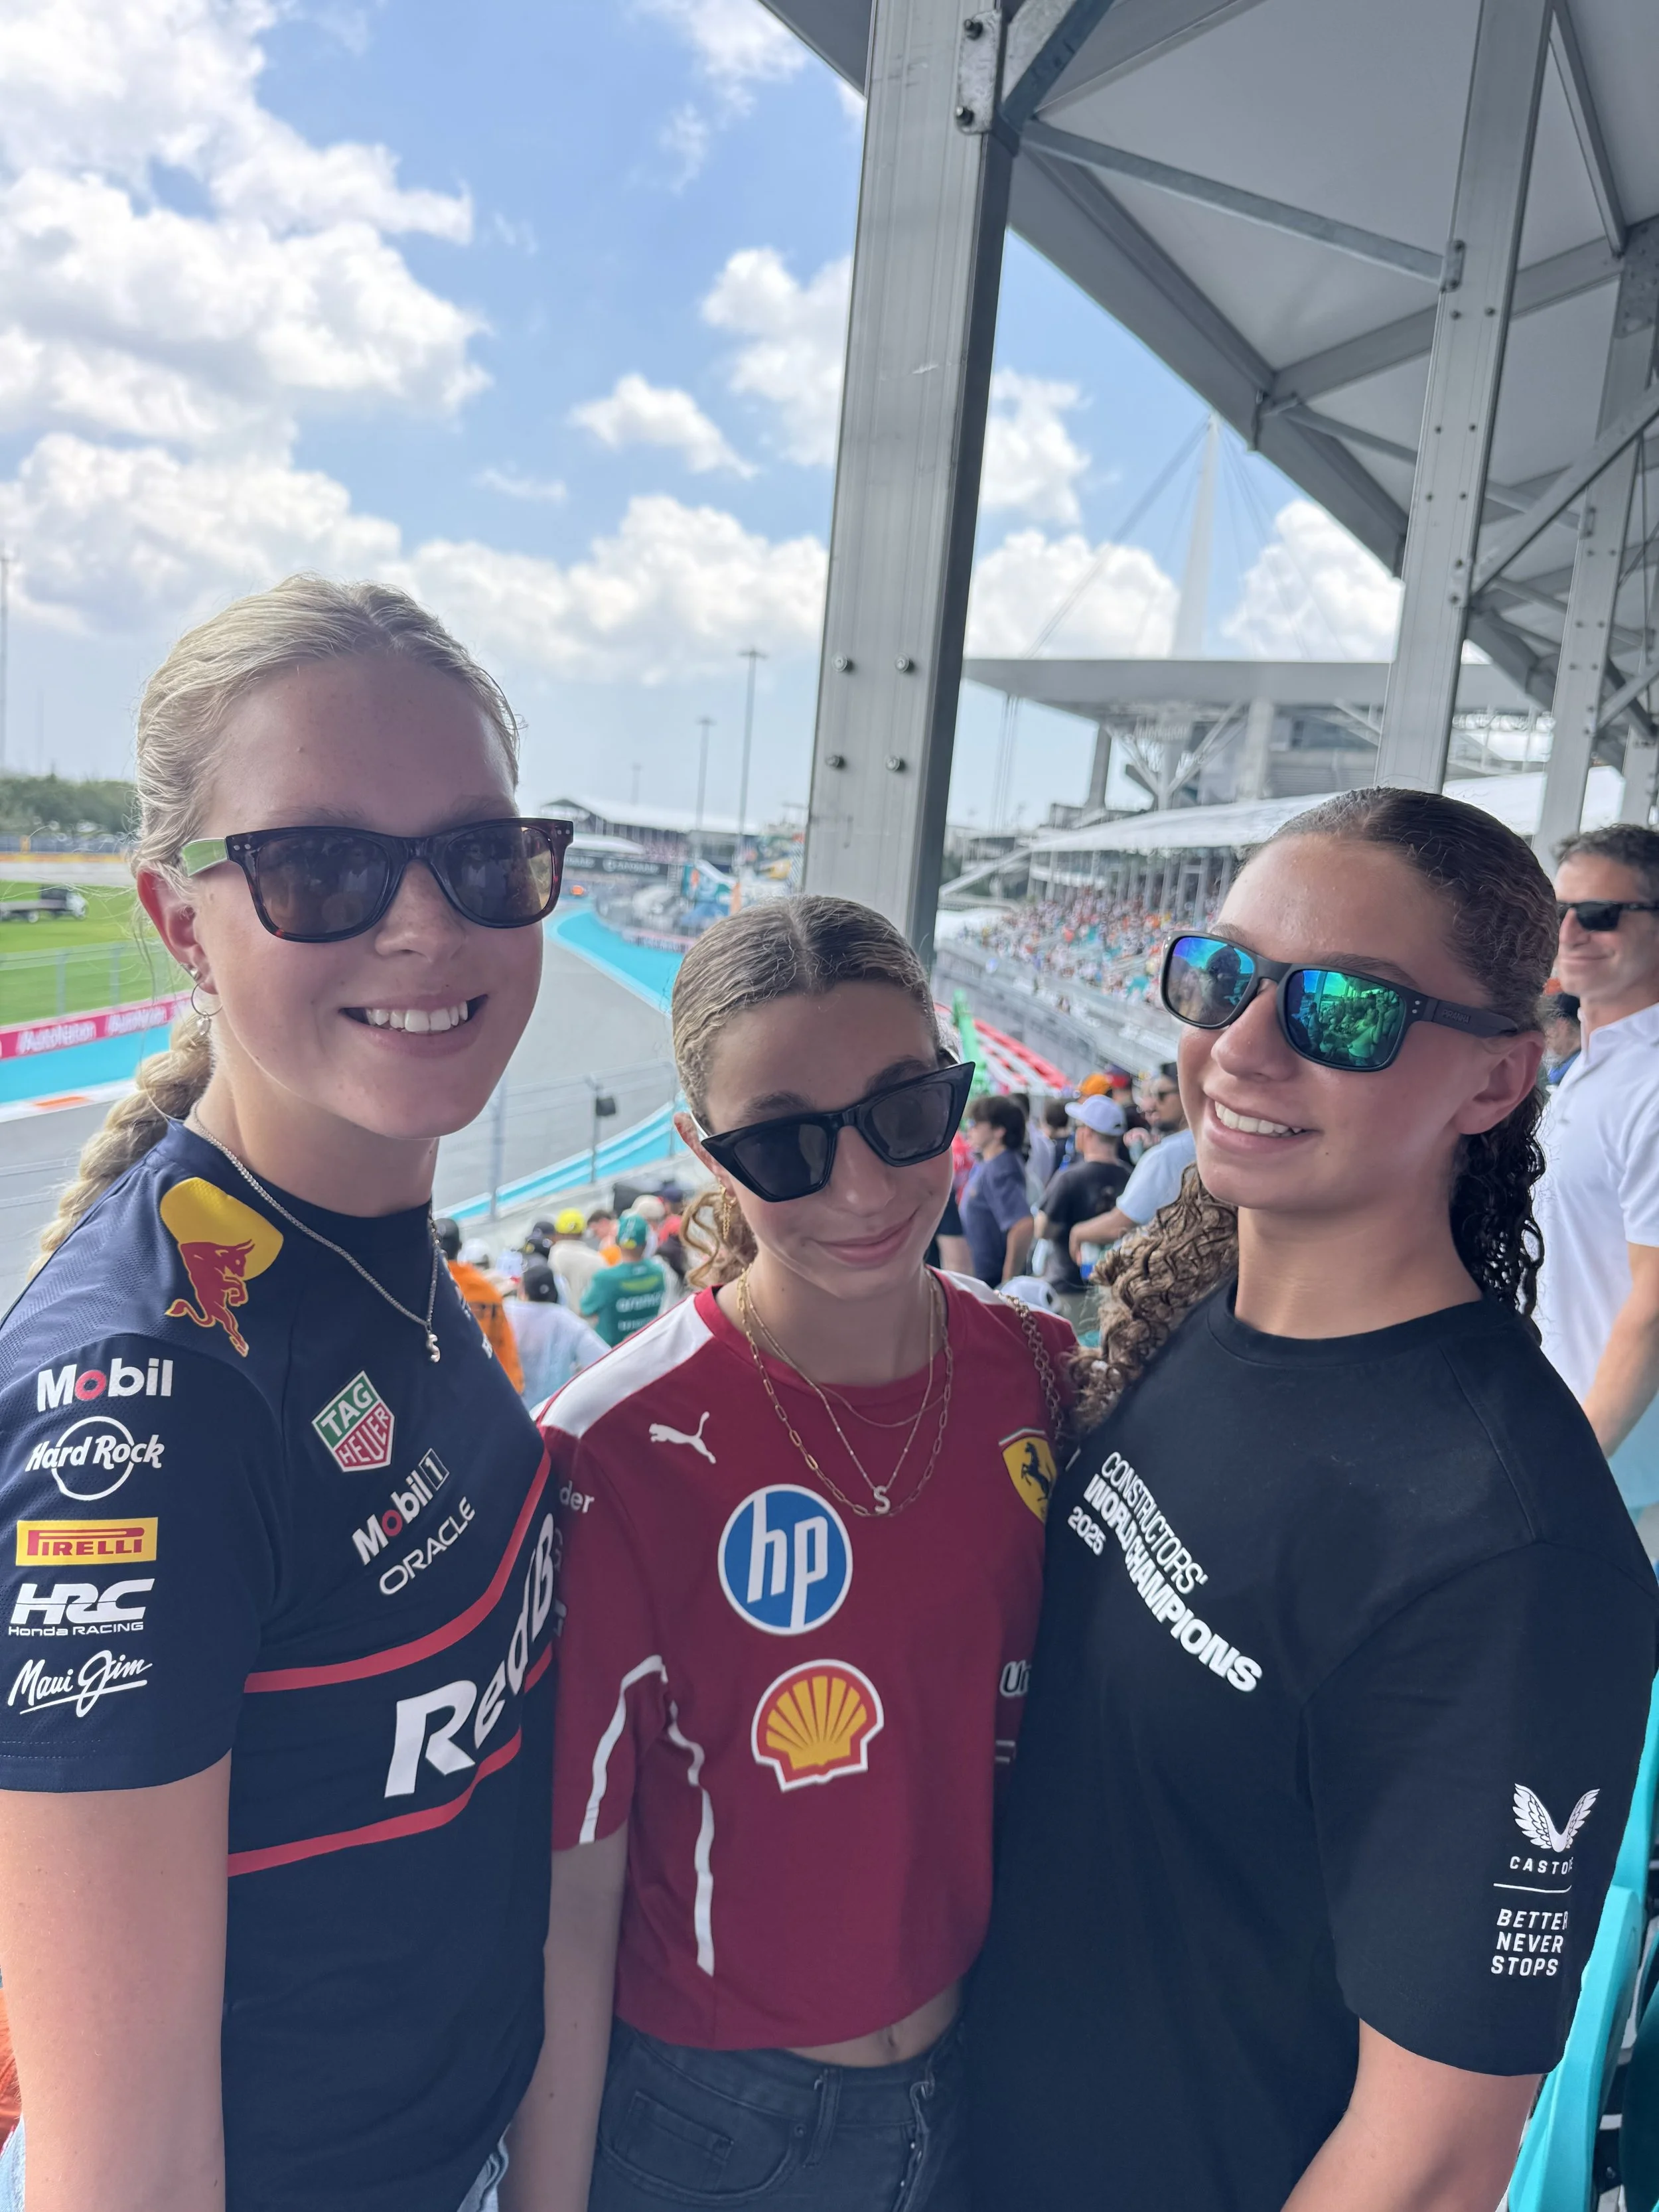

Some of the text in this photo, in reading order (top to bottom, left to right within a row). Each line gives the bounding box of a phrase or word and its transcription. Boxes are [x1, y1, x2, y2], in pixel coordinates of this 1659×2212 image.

[37, 1358, 173, 1412] Mobil
[321, 1382, 374, 1437] TAG
[25, 1435, 165, 1472] Hard Rock
[338, 1406, 389, 1463] HEUER
[352, 1469, 433, 1566] Mobil
[873, 1485, 891, 1514] S
[27, 1527, 145, 1556] PIRELLI
[379, 1497, 475, 1595] ORACLE
[1068, 1506, 1106, 1556] 2025
[747, 1493, 828, 1630] hp
[1084, 1473, 1262, 1692] WORLD CHAMPIONS
[11, 1578, 155, 1624] HRC
[8, 1622, 144, 1636] Honda RACING
[7, 1650, 153, 1718] Maui Jim
[1496, 1908, 1568, 1931] BETTER
[1496, 1931, 1563, 1953] NEVER
[1490, 1955, 1559, 1976] STOPS
